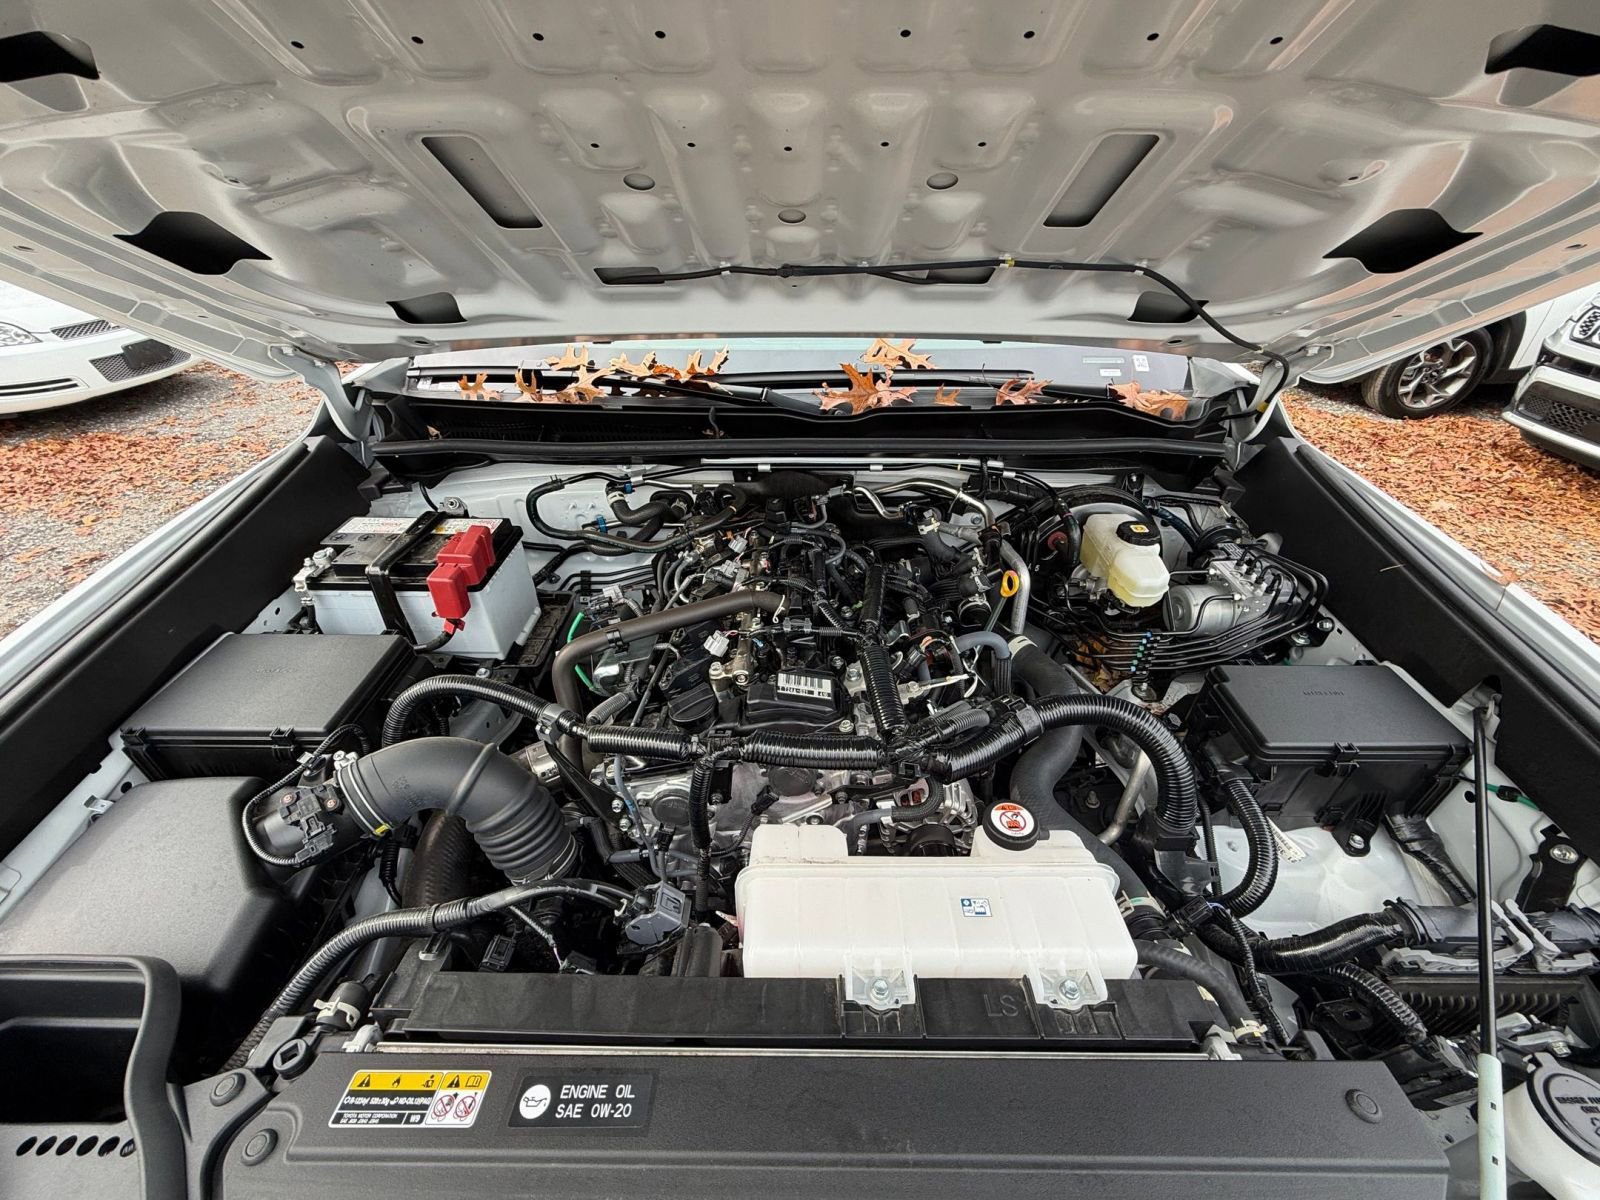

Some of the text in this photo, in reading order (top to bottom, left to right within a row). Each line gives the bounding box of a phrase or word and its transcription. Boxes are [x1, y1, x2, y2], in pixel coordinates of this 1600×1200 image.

[983, 994, 1019, 1017] LS
[560, 1084, 635, 1099] ENGINE OIL
[555, 1103, 632, 1118] SAE 0W-20
